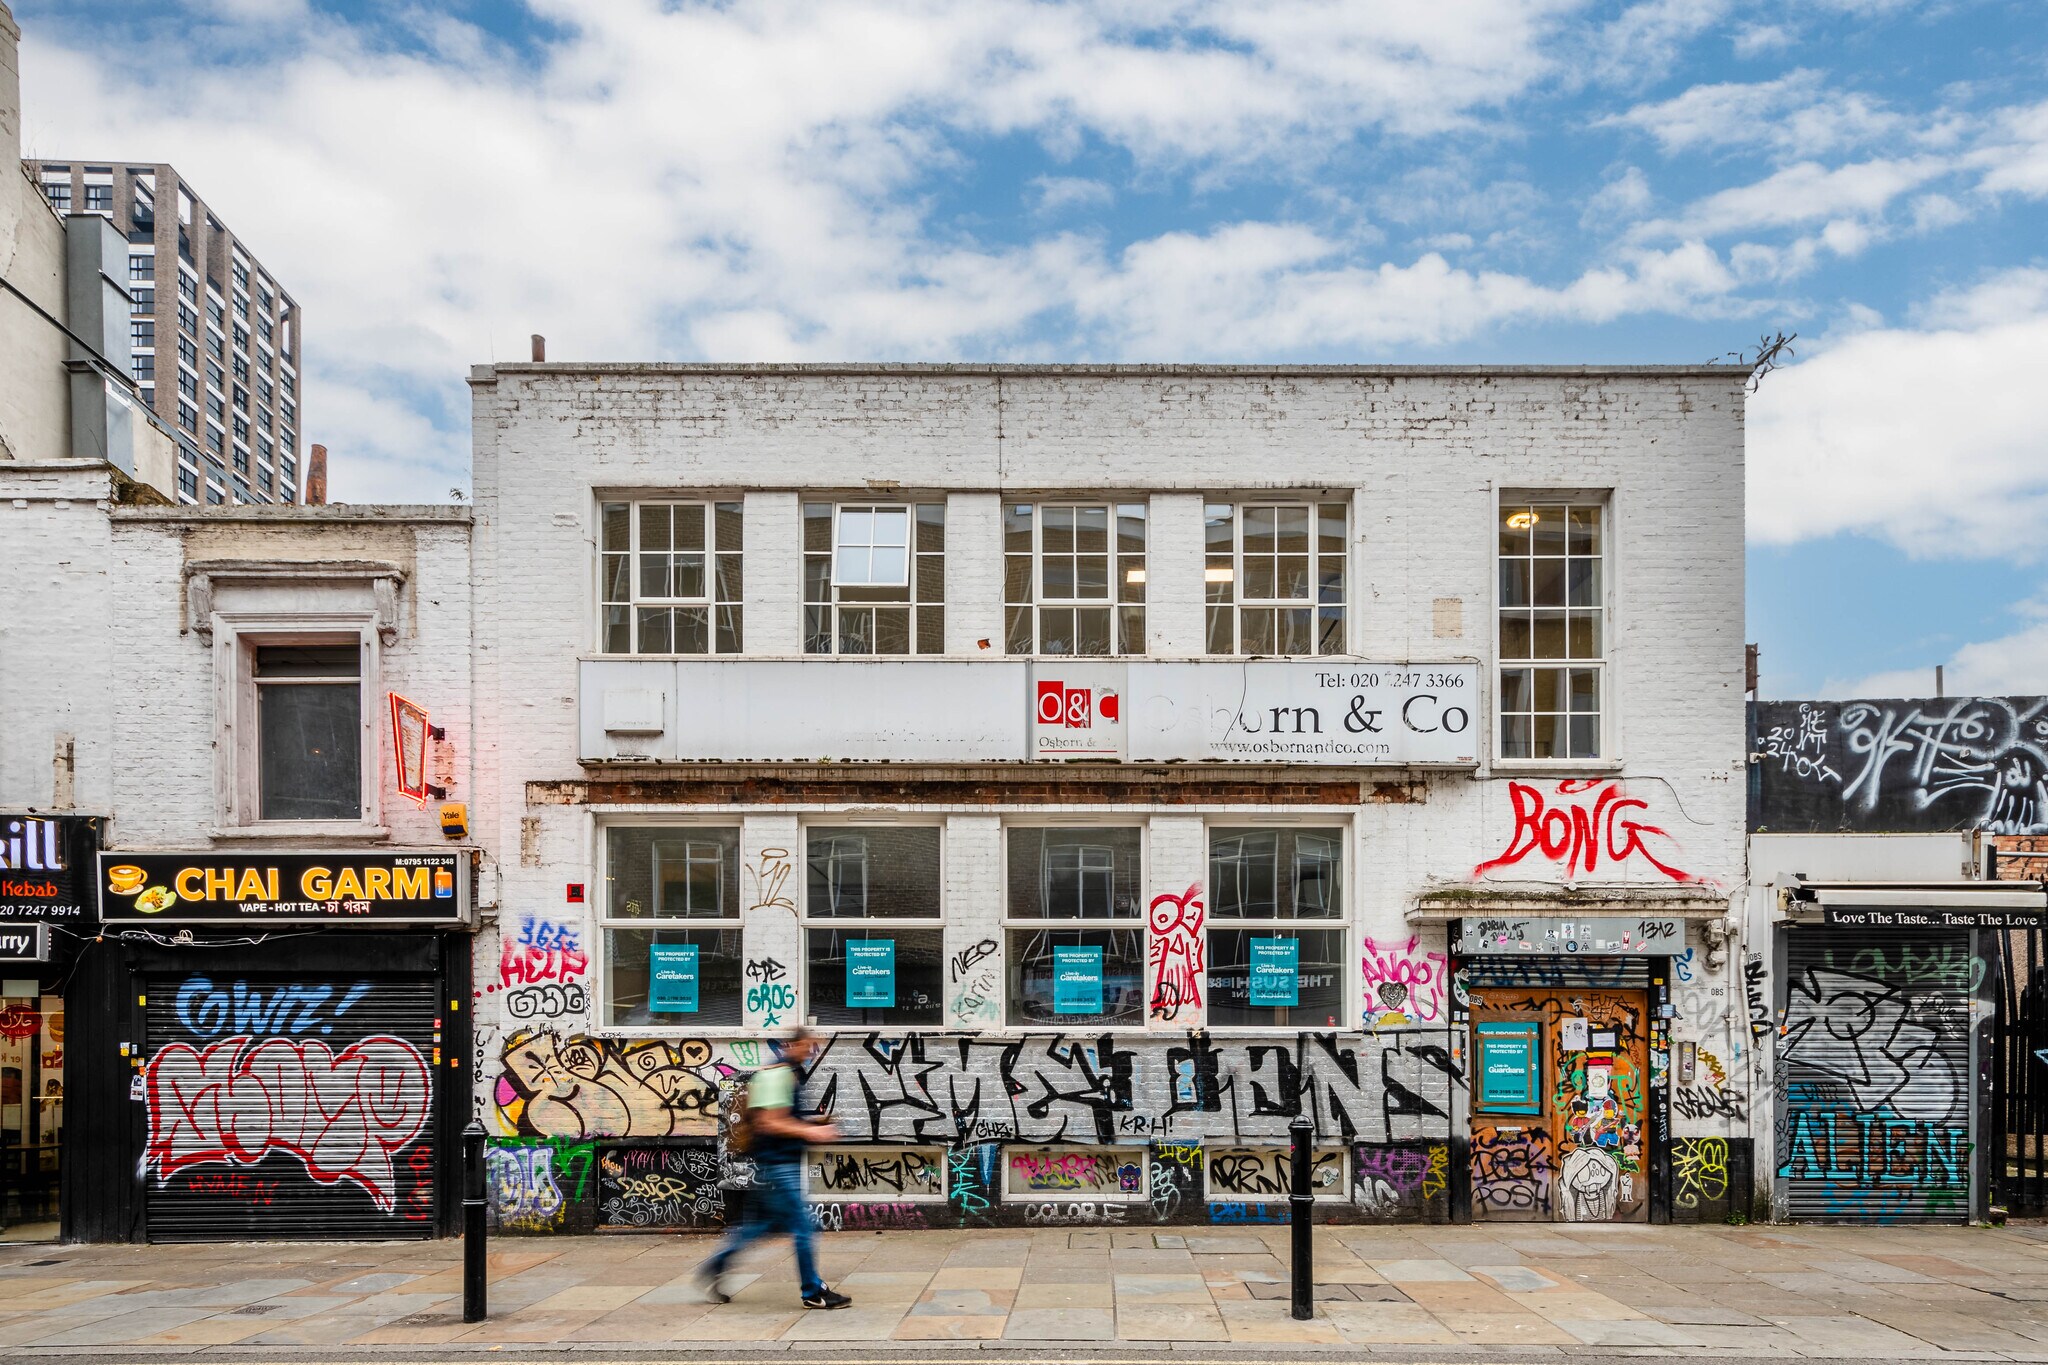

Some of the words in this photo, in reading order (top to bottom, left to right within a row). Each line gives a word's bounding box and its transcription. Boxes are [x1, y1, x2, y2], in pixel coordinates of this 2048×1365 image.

[1315, 673, 1346, 688] Tel:
[1350, 673, 1379, 688] 020
[1425, 673, 1464, 688] 3366
[1343, 694, 1384, 734] &
[1402, 694, 1470, 734] Co
[1210, 740, 1390, 754] www.osbornandco.com
[1470, 781, 1695, 882] BONG
[2, 880, 58, 897] Kebab
[175, 866, 280, 902] CHAI
[301, 866, 431, 901] GARM
[18, 905, 48, 916] 7247
[51, 905, 81, 916] 9914
[239, 903, 268, 912] VAPE
[275, 902, 297, 912] HOT
[299, 902, 320, 912] TEA
[1833, 911, 1866, 924] Love
[1867, 912, 1893, 924] The
[1895, 912, 1941, 925] Taste...
[1942, 913, 1975, 925] Taste
[1978, 913, 2003, 925] The
[2006, 914, 2039, 926] Love
[1711, 988, 1724, 996] OBS
[1777, 1110, 1969, 1182] ALIEN
